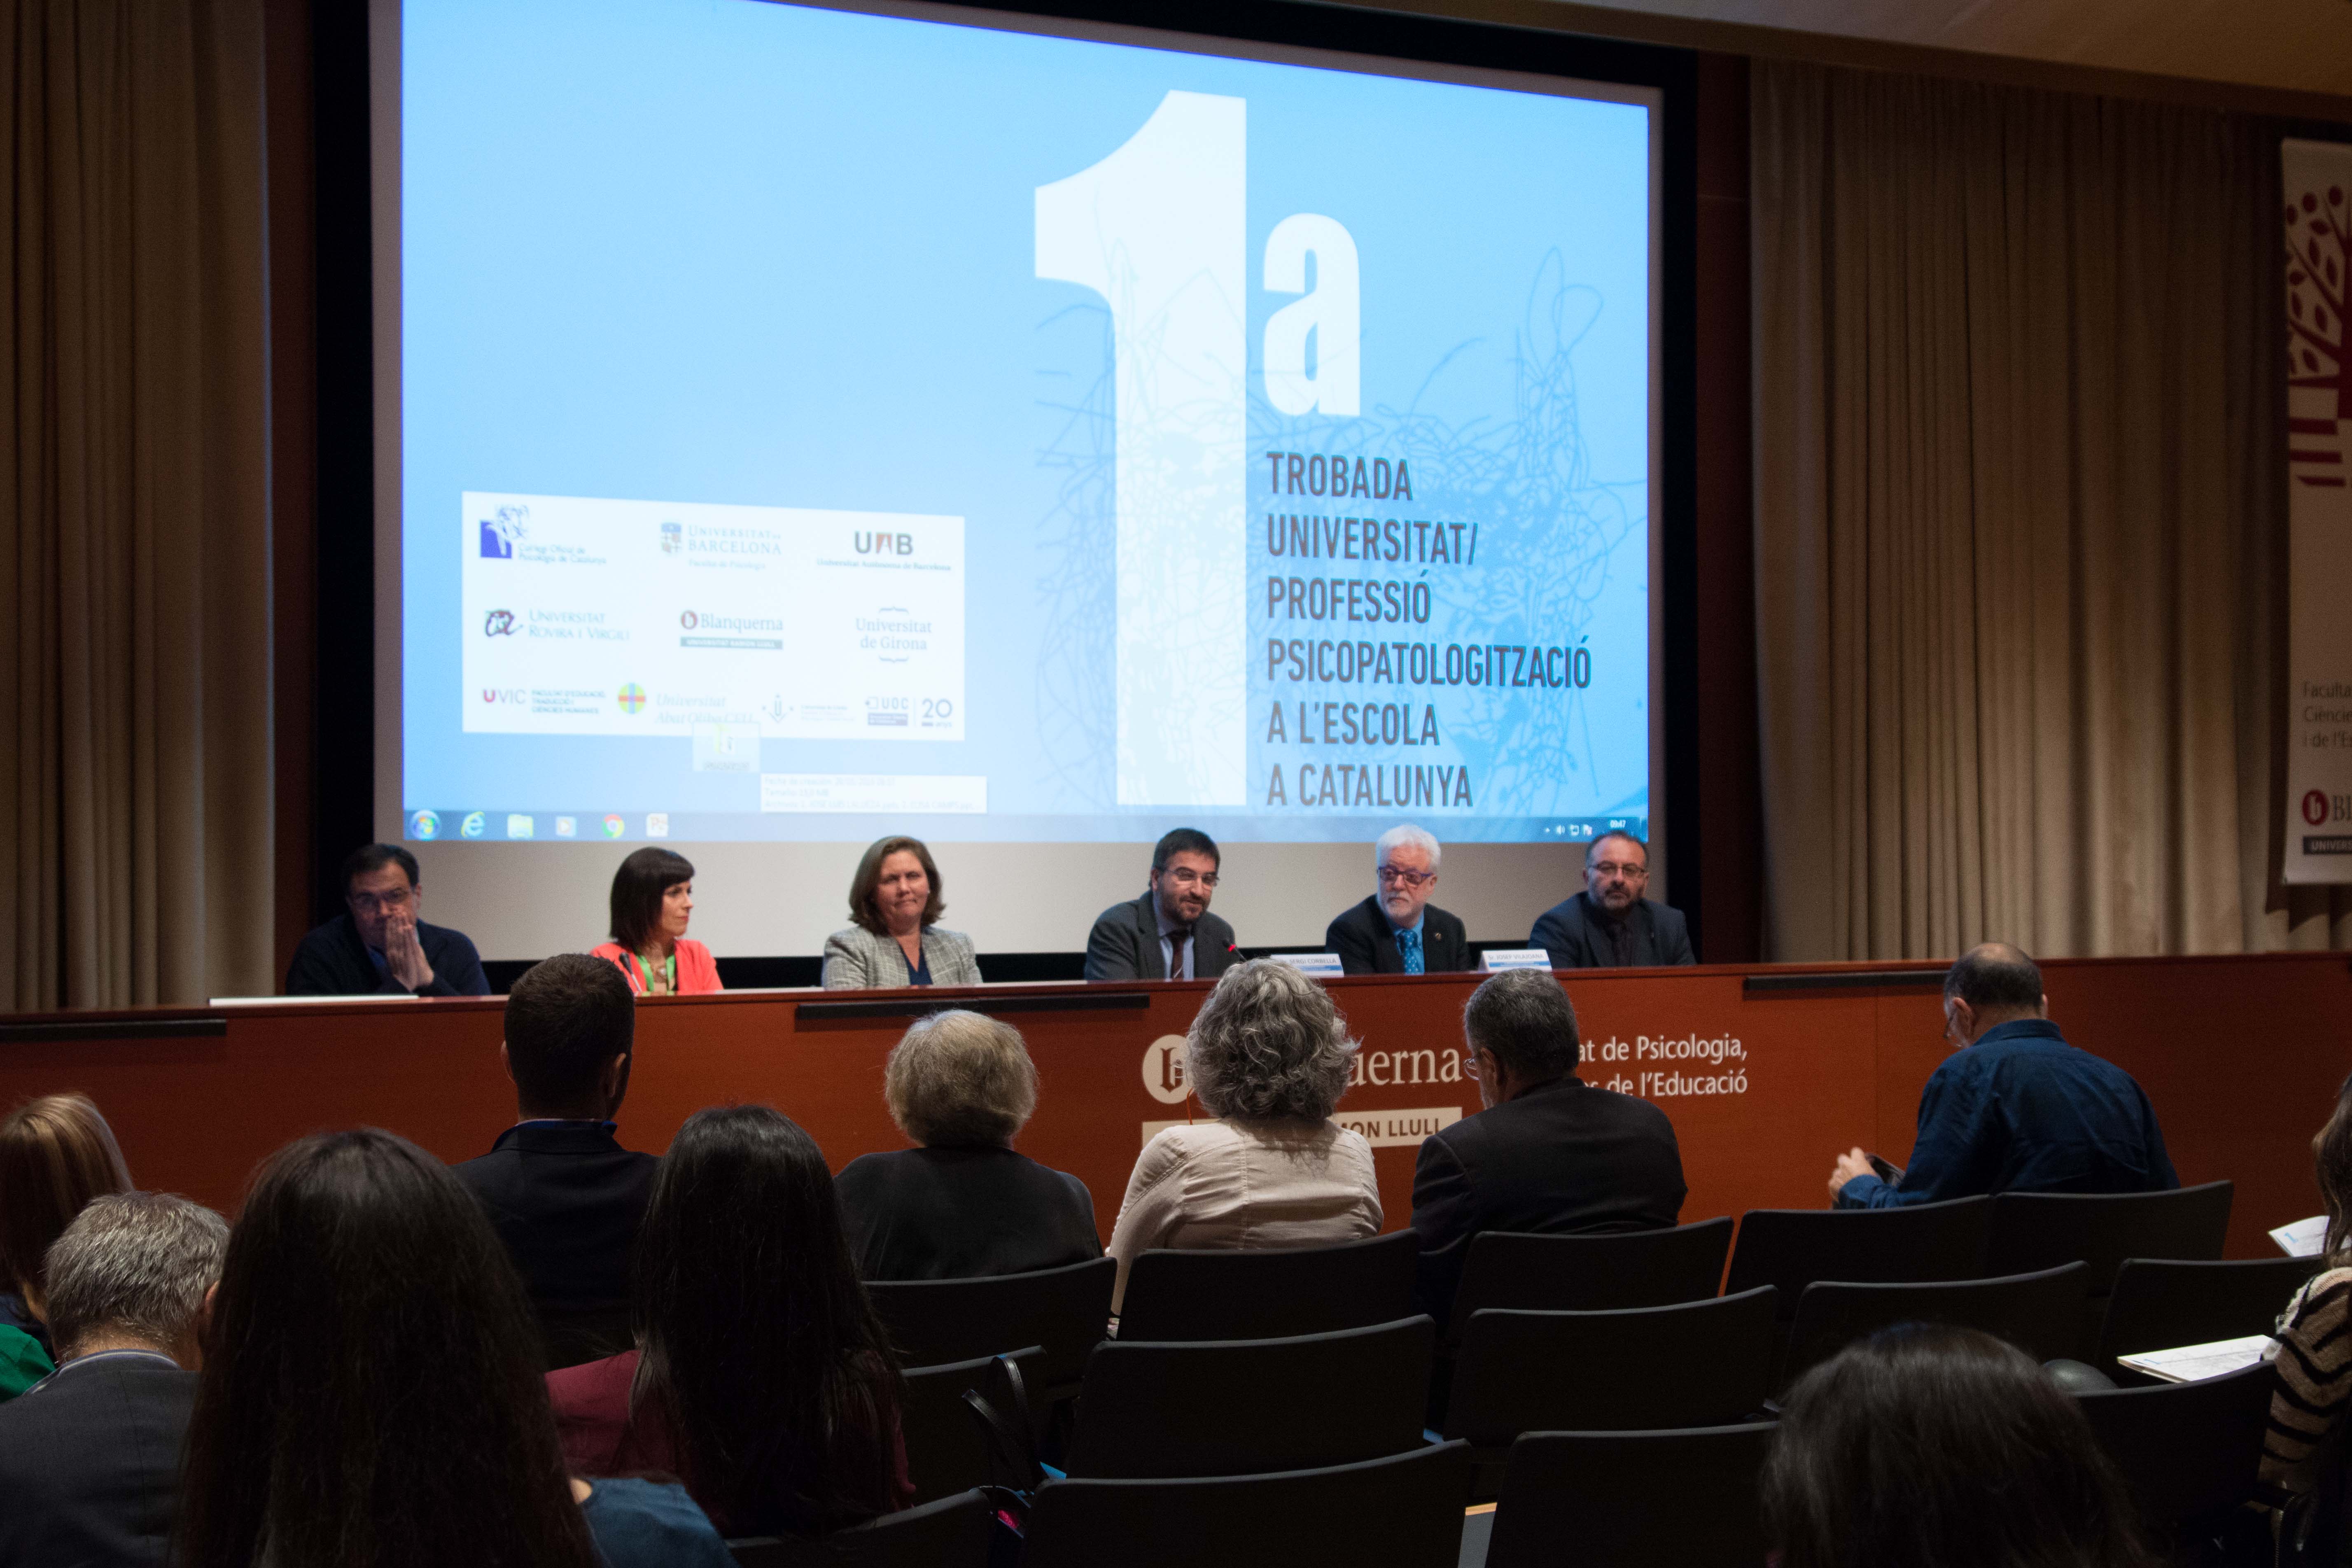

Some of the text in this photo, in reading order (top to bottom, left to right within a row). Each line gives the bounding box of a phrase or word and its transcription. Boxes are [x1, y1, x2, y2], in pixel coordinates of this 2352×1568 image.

[1267, 451, 1413, 501] TROBADA
[688, 539, 782, 555] BARCELONA
[854, 530, 914, 556] UAB
[1268, 513, 1478, 565] UNIVERSITAT/
[817, 558, 860, 567] Universitat
[913, 562, 951, 572] Barcelona
[1268, 569, 1431, 624] PROFESSIÓ
[700, 613, 783, 634] Blanquerna
[855, 617, 933, 633] Universitat
[860, 635, 927, 650] de Girona
[1268, 635, 1592, 688] PSICOPATOLOGITZACIÓ
[483, 689, 526, 705] UVIC
[656, 693, 727, 707] Universitat
[2303, 681, 2352, 698] Faculta
[882, 697, 909, 709] UOC
[922, 698, 952, 719] 20
[1267, 701, 1440, 747] A L'ESCOLA
[1267, 763, 1474, 808] A CATALUNYA
[1603, 1036, 1630, 1061] de
[1637, 1033, 1748, 1065] Psicologia,
[1641, 1068, 1748, 1097] l'Educació
